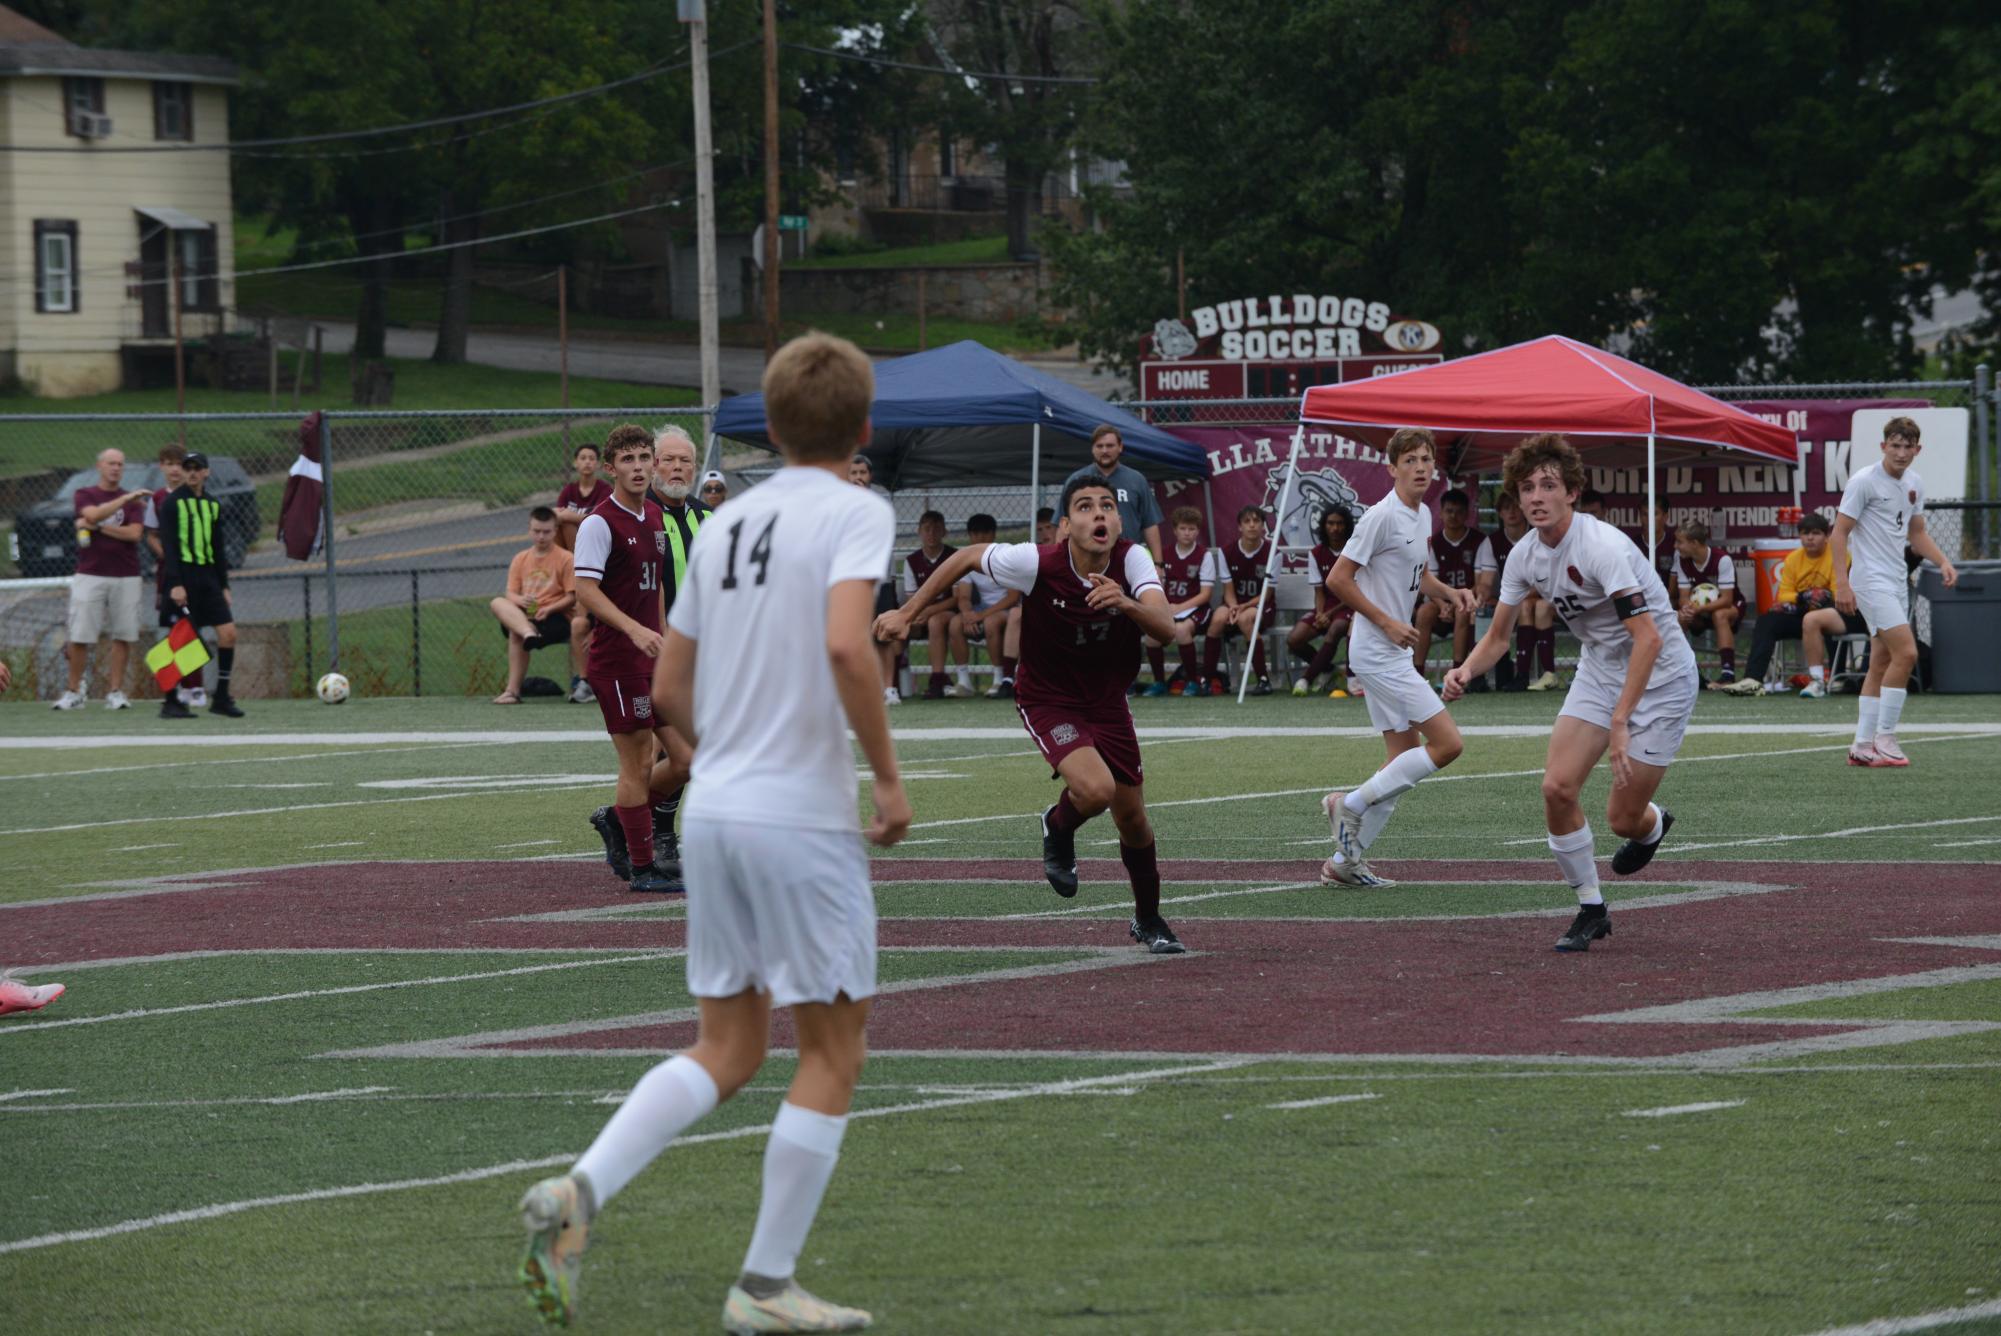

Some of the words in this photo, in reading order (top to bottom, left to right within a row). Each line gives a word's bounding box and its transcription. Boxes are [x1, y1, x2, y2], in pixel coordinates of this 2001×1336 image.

[1192, 294, 1390, 338] BULLDOGS
[1221, 328, 1362, 360] SOCCER
[1157, 370, 1210, 390] HOME
[1164, 437, 1278, 498] RLLA
[1117, 489, 1129, 502] R
[722, 512, 779, 589] 14
[639, 561, 657, 590] 31
[1168, 581, 1188, 596] 26
[1237, 580, 1257, 596] 30
[1553, 594, 1587, 622] 25
[1075, 621, 1111, 646] 17
